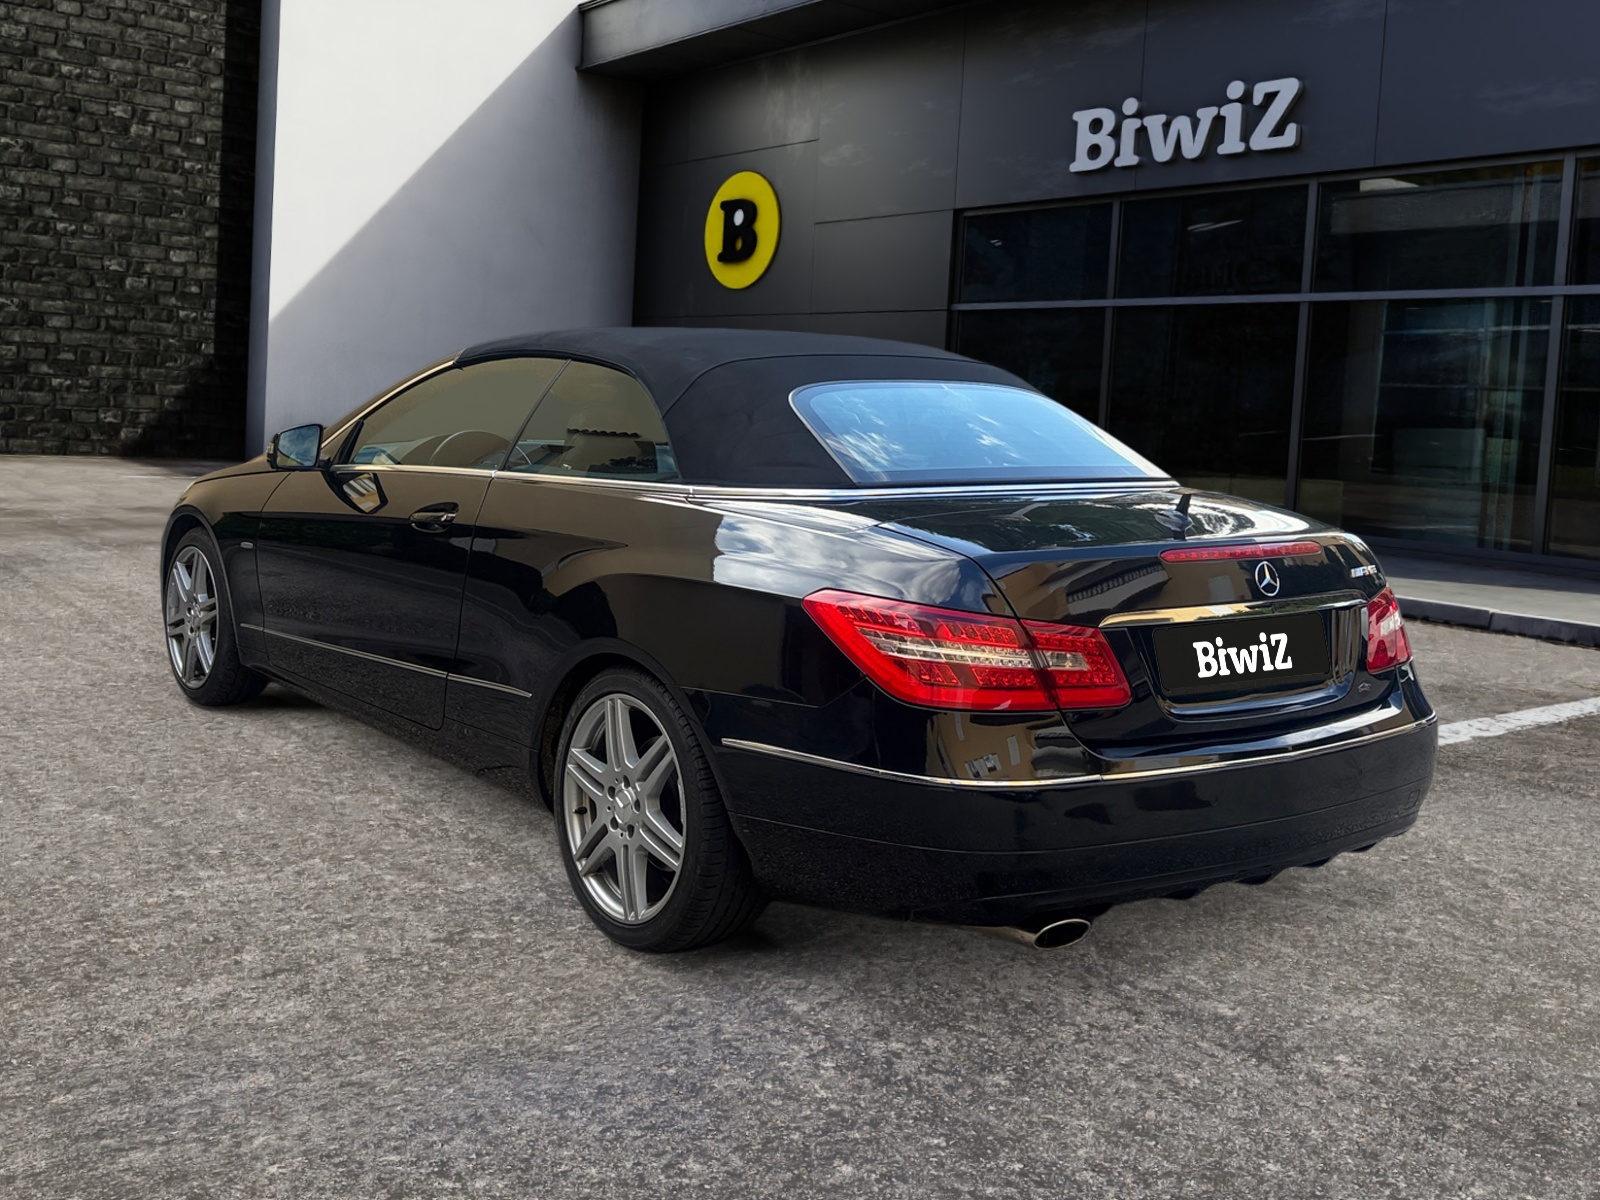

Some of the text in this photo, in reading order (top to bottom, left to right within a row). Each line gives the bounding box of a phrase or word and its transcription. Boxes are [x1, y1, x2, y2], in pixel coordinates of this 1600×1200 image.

[1069, 77, 1301, 172] BiwiZ
[717, 199, 758, 264] B
[1192, 632, 1293, 678] BiwiZ
